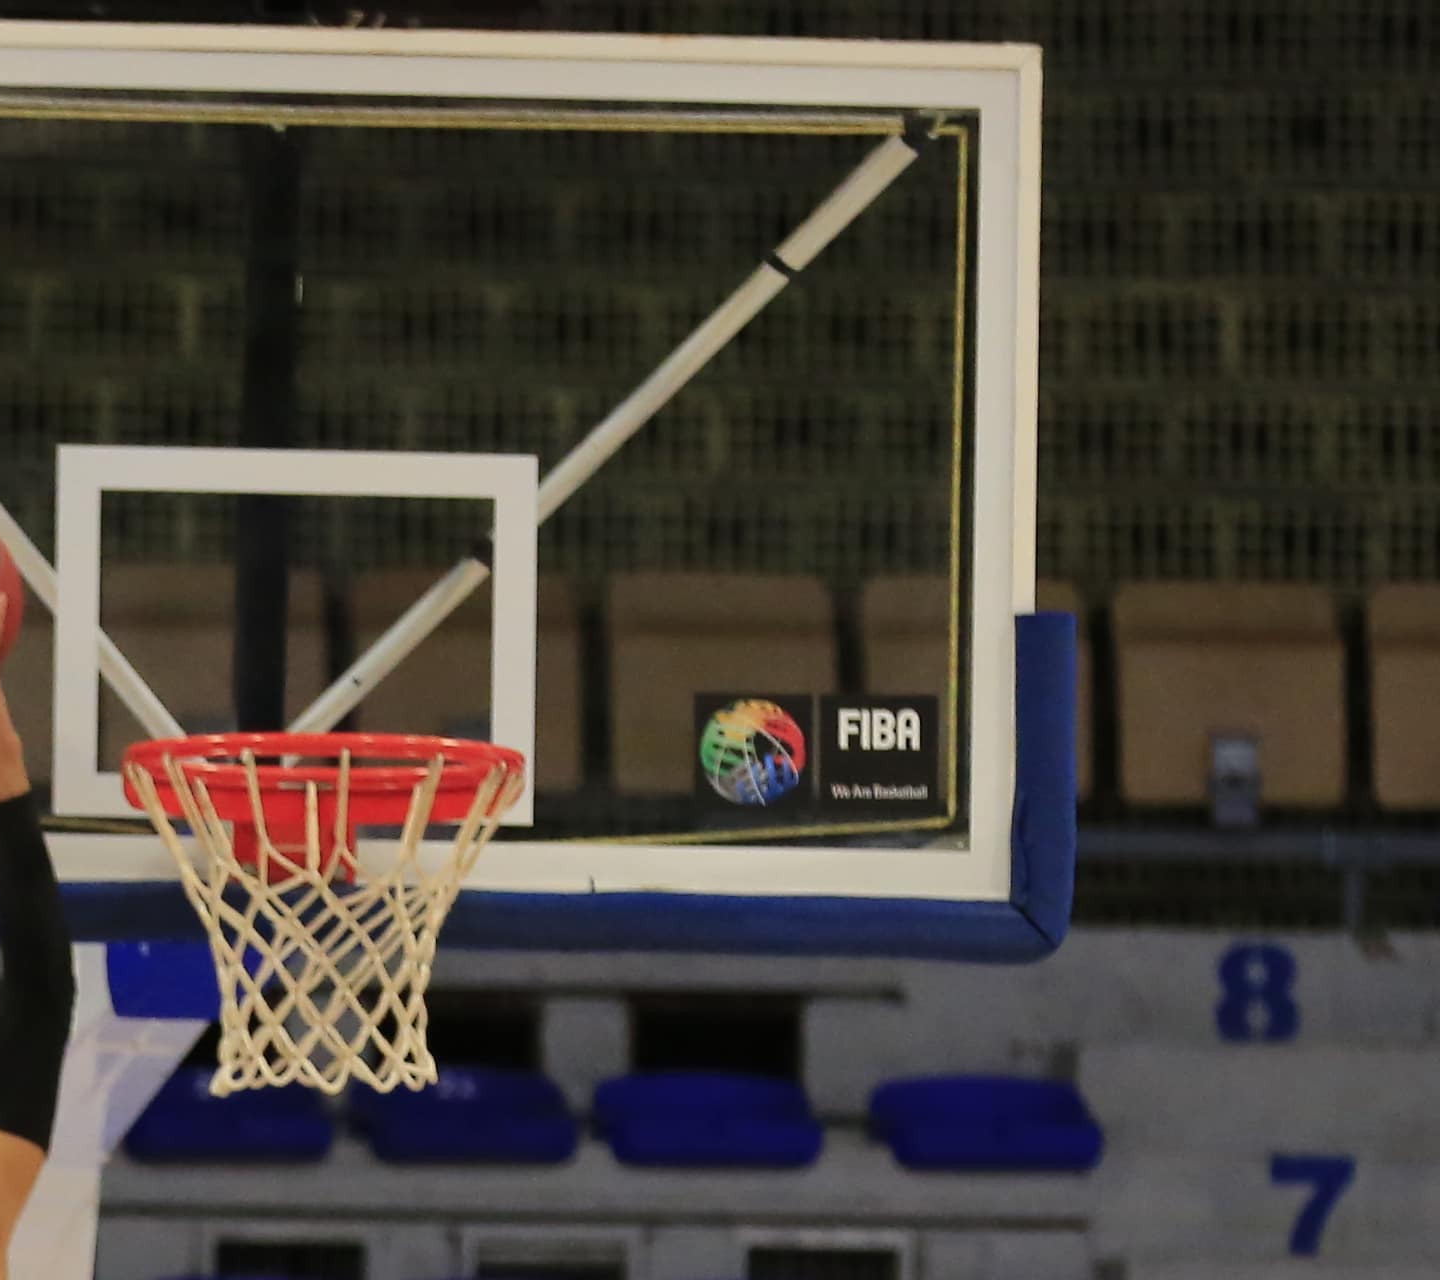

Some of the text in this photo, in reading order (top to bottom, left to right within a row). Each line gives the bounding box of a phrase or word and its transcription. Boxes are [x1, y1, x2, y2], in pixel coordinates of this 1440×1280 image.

[837, 707, 921, 751] FIBA
[1216, 940, 1302, 1045] 8
[1269, 1152, 1356, 1258] 7
